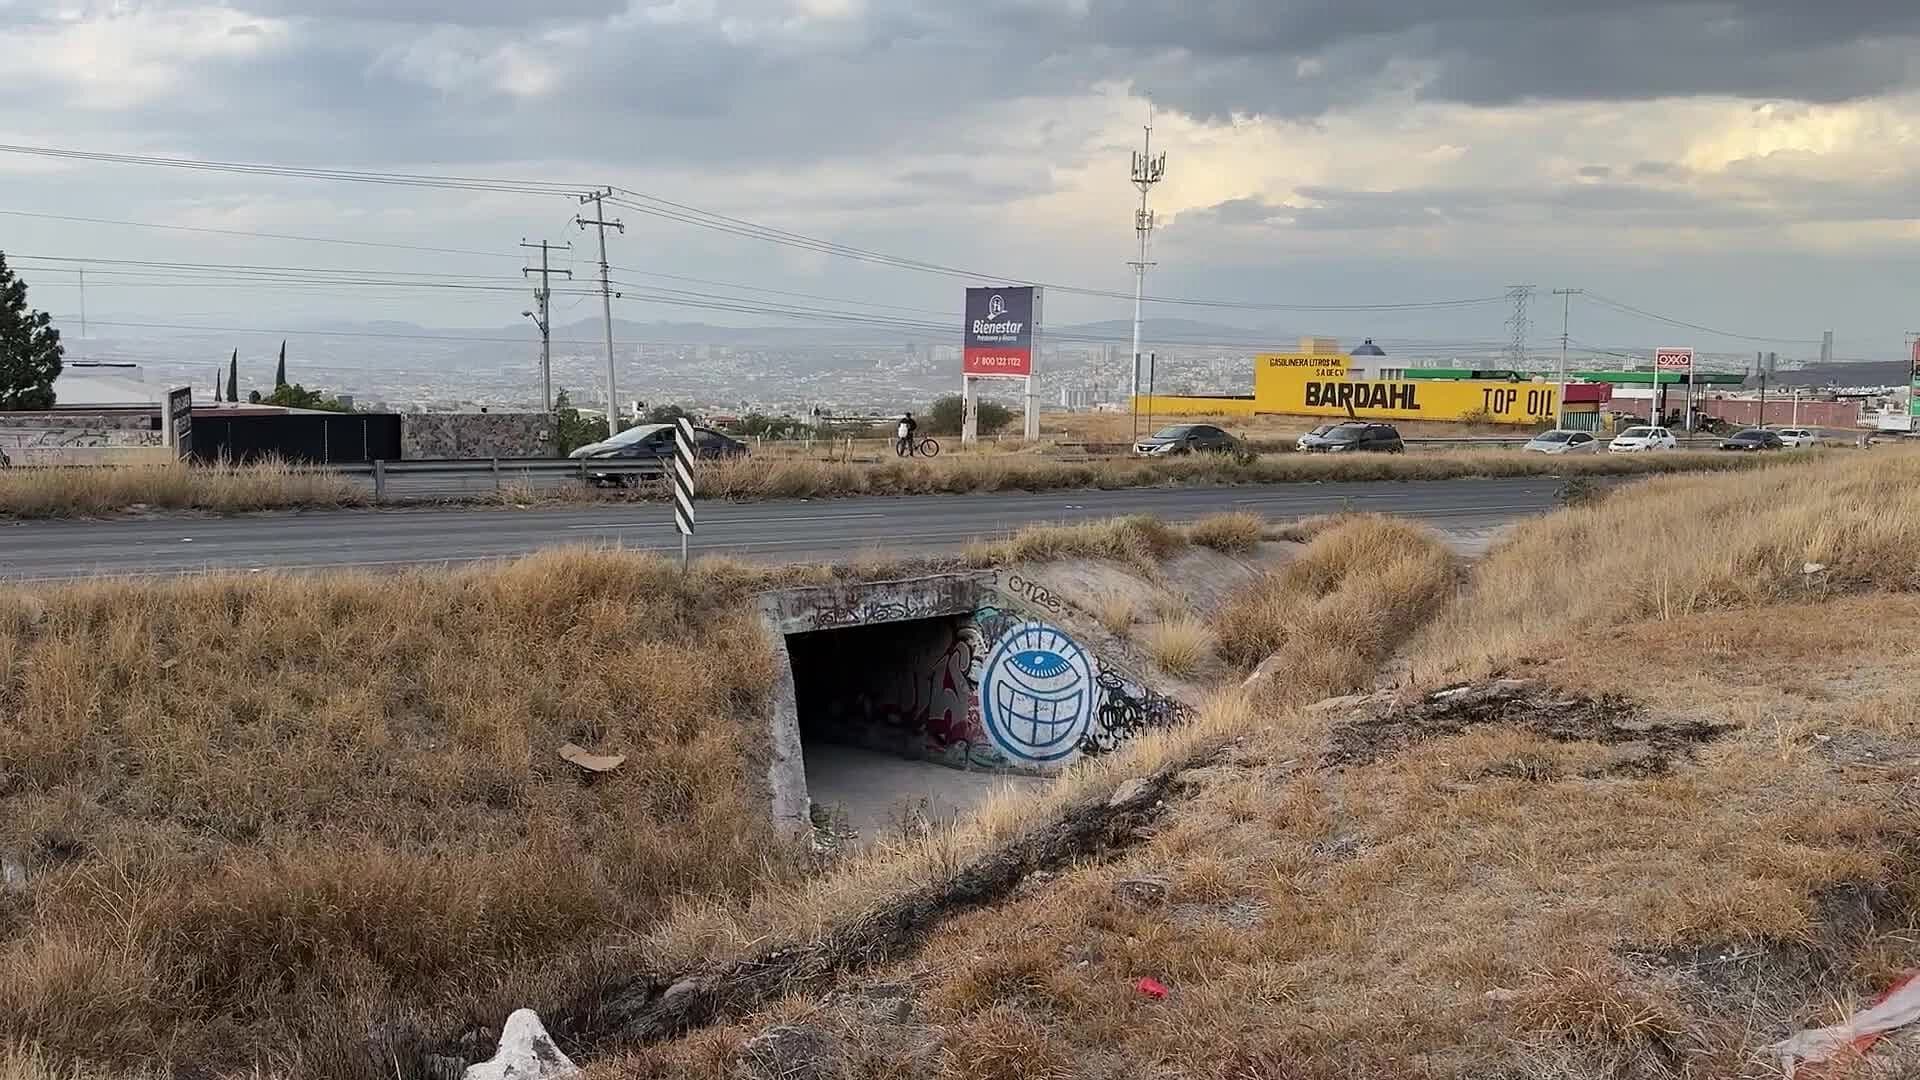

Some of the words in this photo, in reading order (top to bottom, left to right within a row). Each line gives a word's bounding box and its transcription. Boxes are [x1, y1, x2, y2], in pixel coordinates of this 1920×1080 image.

[973, 320, 1023, 334] Bienestar
[981, 357, 995, 366] 800
[1269, 358, 1308, 367] GASOLINERA
[1659, 355, 1689, 366] OXXO
[1305, 382, 1421, 418] BARDAHL
[1483, 388, 1517, 416] TOP
[1527, 389, 1553, 417] OIL
